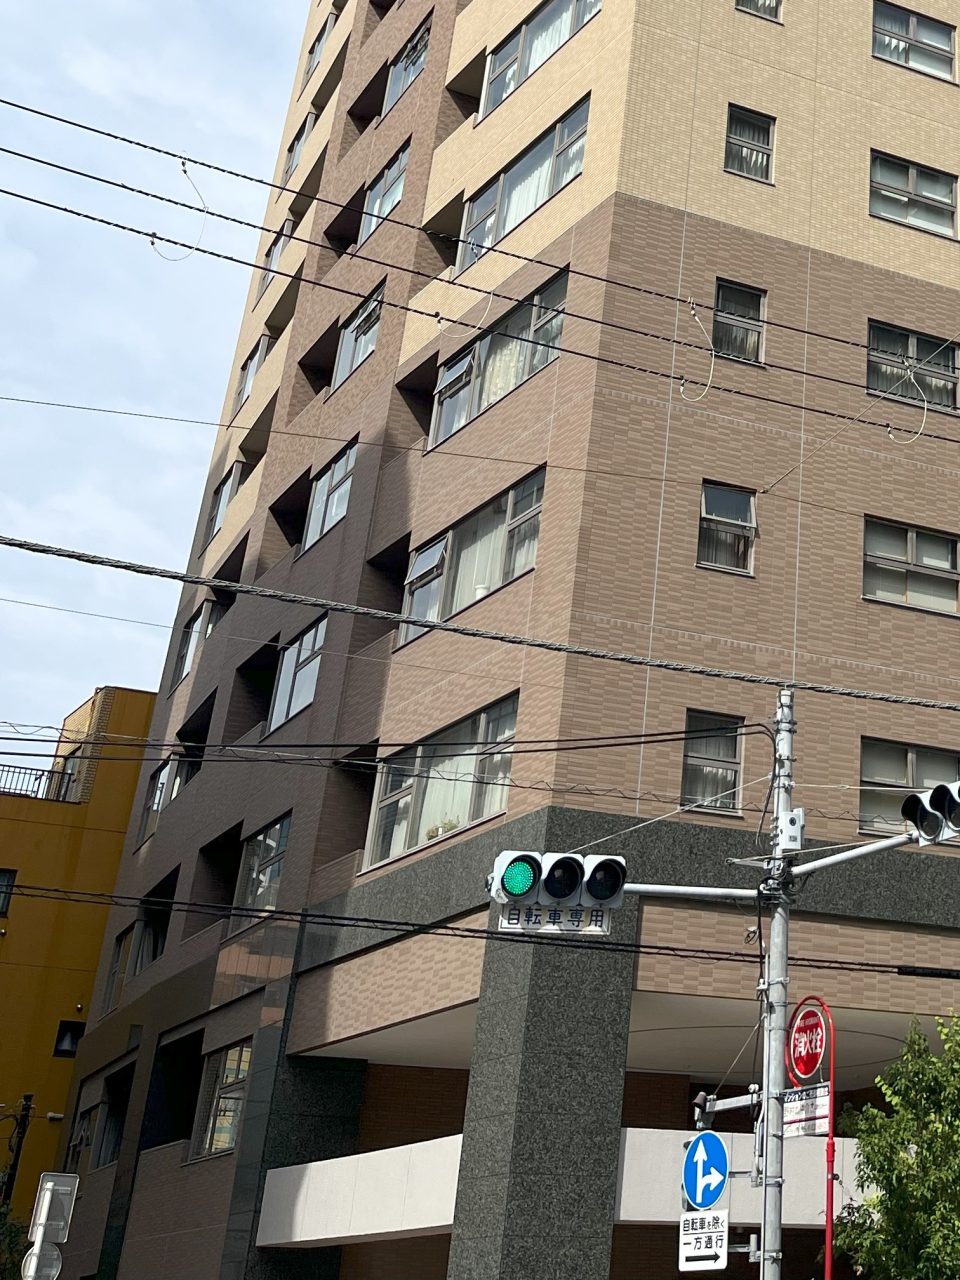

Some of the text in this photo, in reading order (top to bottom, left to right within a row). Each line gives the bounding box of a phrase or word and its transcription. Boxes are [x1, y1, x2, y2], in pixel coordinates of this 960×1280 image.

[507, 907, 604, 928] 自転車専用
[794, 1027, 823, 1058] 消火栓
[683, 1216, 725, 1232] 自転車を除く
[683, 1234, 724, 1251] 一方通行
